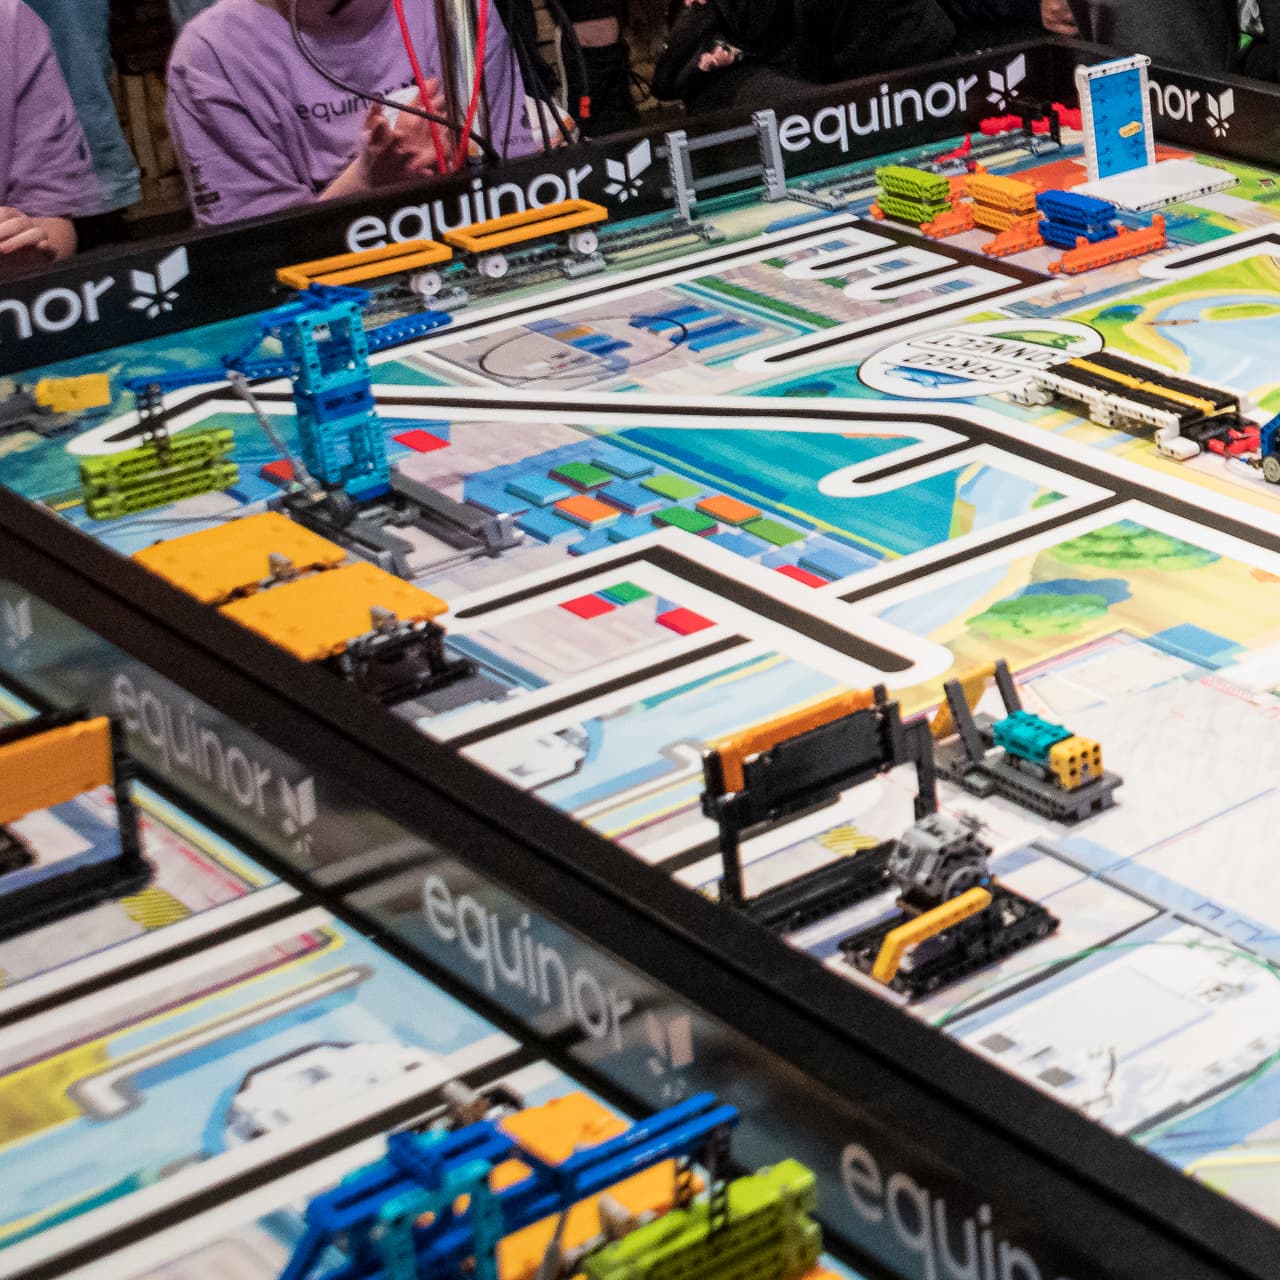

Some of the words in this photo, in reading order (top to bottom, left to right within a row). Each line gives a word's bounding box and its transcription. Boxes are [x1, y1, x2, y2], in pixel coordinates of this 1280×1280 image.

[778, 73, 979, 153] equinor
[346, 164, 593, 254] equinor
[112, 673, 271, 818] equinor
[423, 874, 632, 1052] equinor
